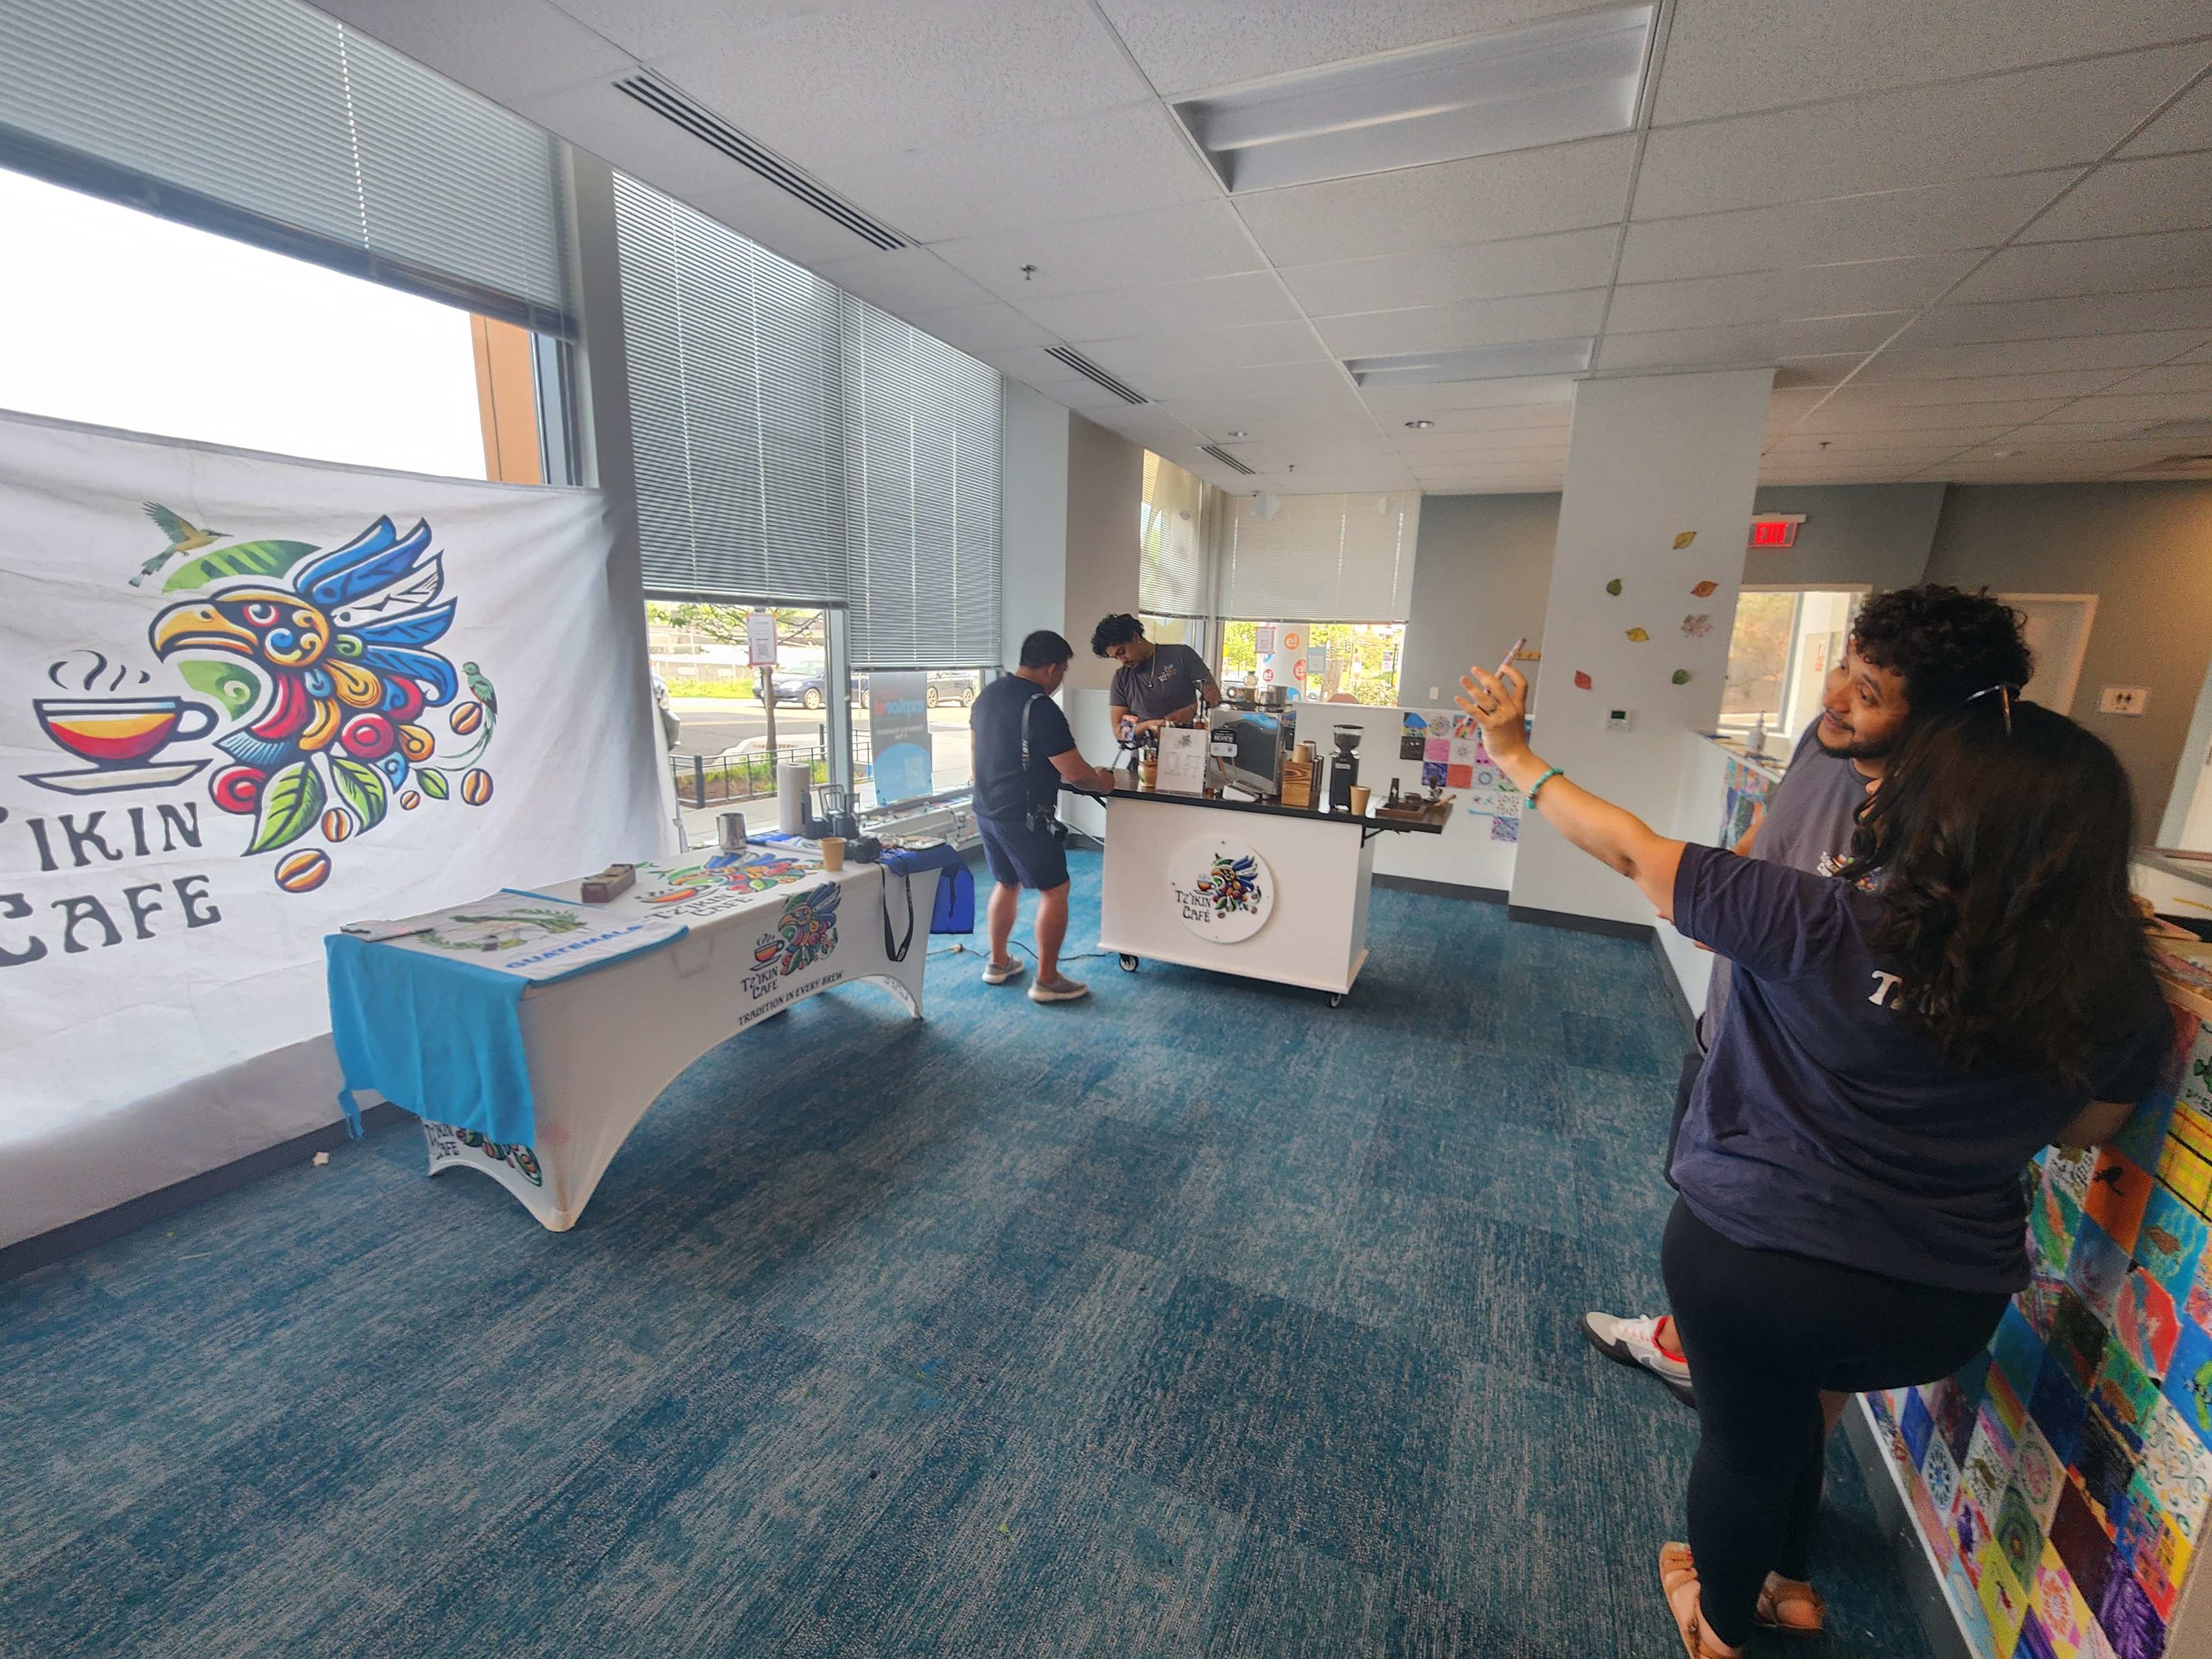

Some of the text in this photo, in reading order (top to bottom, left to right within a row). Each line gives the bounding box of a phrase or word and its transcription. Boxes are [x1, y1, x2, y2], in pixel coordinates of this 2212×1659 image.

[505, 925, 644, 968] GUATEMALA
[738, 970, 844, 1025] TRADITION IN EVERY BREW
